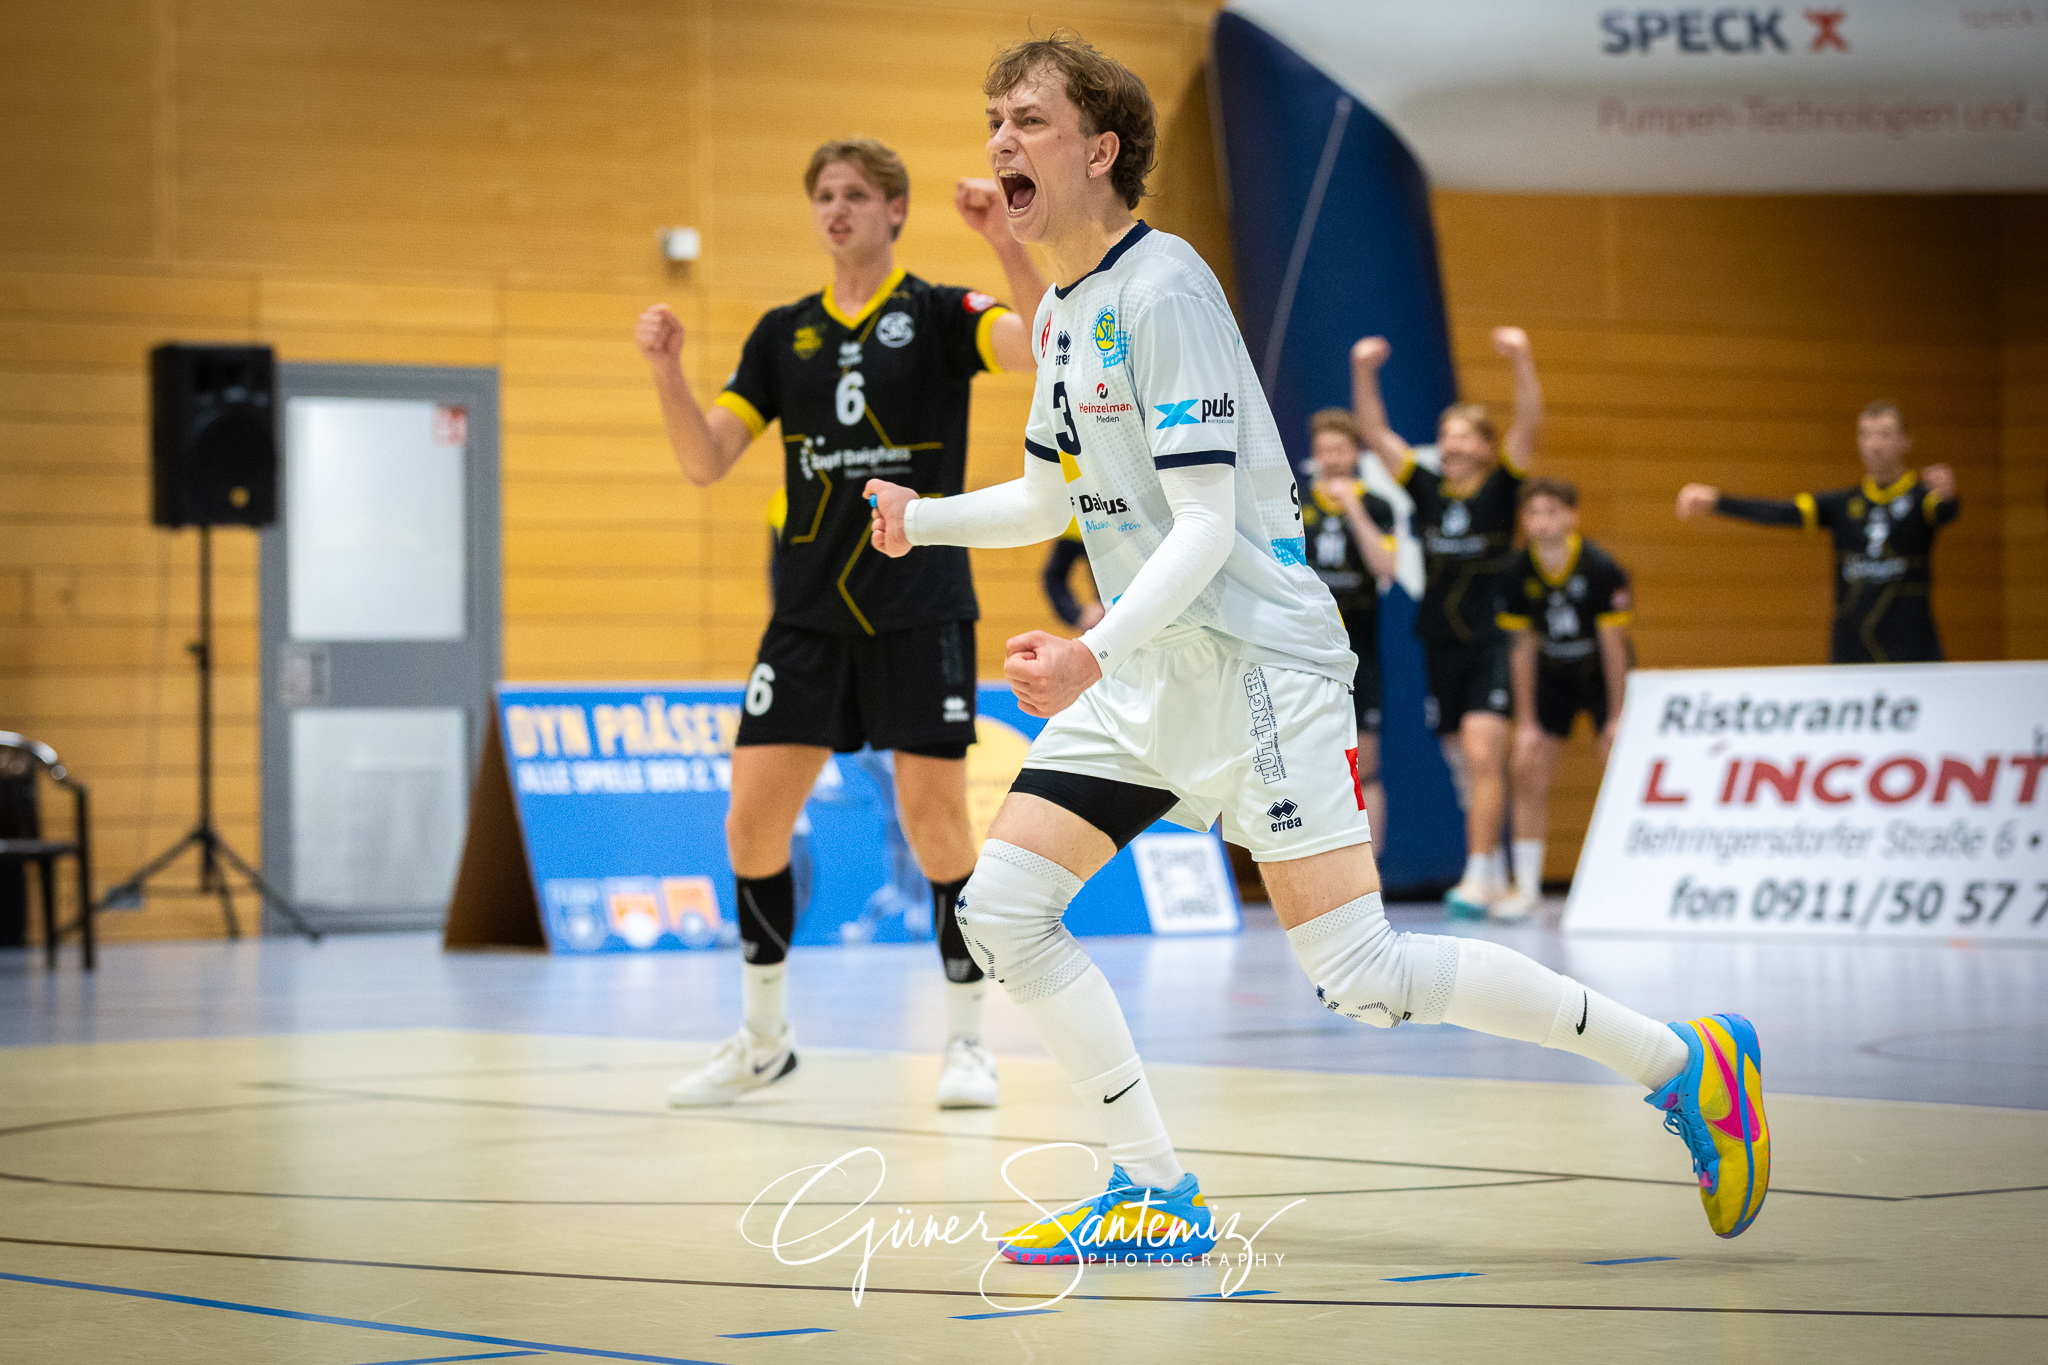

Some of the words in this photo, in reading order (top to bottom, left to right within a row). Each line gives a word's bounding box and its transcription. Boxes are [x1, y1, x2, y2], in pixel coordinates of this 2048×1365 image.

[1600, 8, 1788, 54] SPECK
[836, 371, 866, 426] 6
[1053, 381, 1082, 456] 3
[1096, 415, 1120, 423] Medien
[1201, 392, 1235, 424] puls
[745, 663, 776, 717] 6
[1659, 691, 1920, 734] Ristorante
[505, 705, 592, 756] DYN
[1271, 817, 1302, 832] errea
[1626, 820, 1872, 864] Behringersdorfer
[1882, 818, 1984, 860] Straße
[1994, 819, 2016, 858] 6
[1670, 876, 1738, 922] fon
[1750, 879, 1945, 928] 0911/50
[1958, 881, 2016, 926] 57
